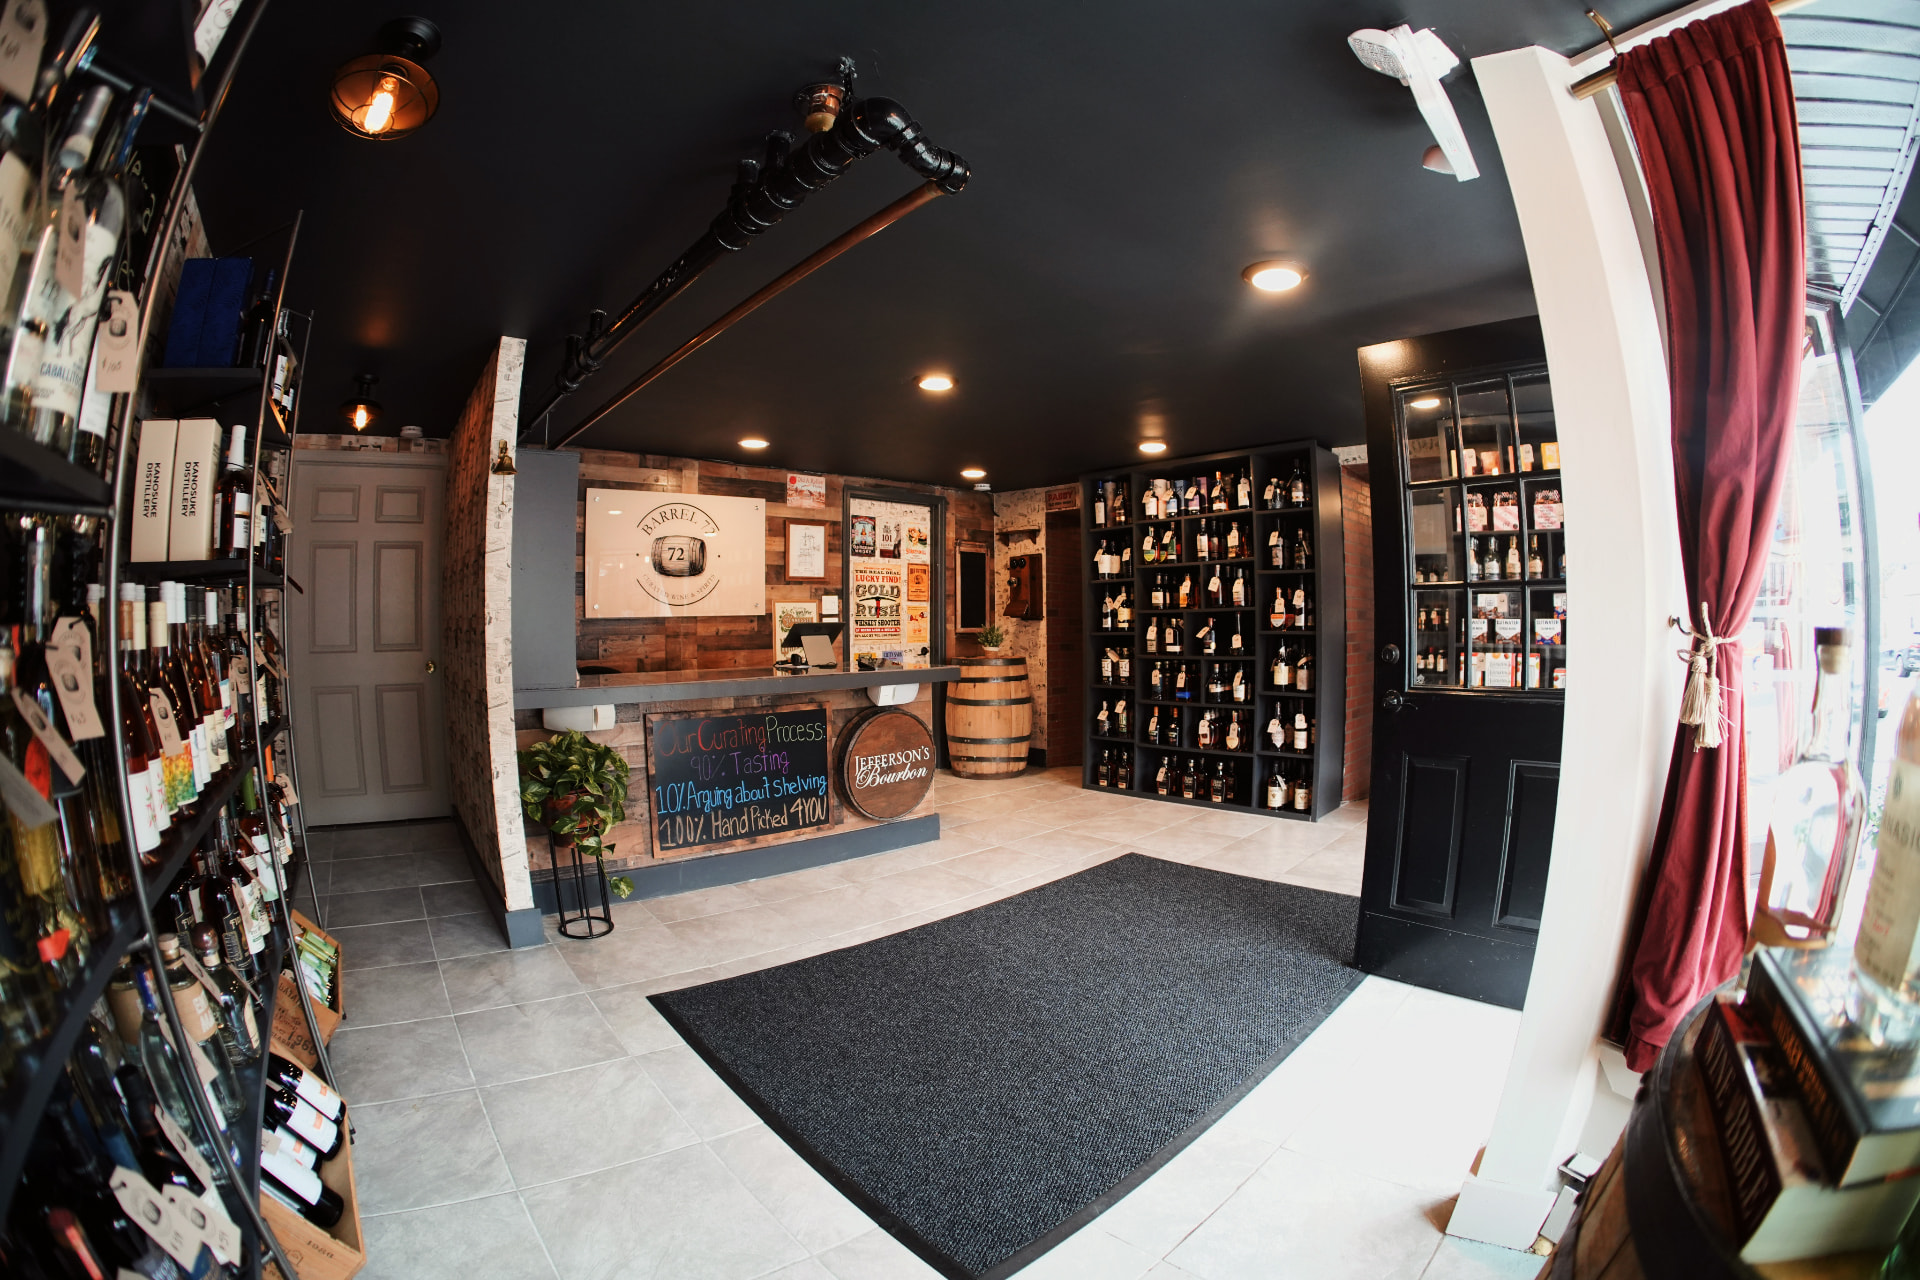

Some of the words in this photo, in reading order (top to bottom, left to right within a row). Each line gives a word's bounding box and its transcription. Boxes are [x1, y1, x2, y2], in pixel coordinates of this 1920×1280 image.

[143, 463, 154, 519] DISTILLERY
[150, 462, 161, 518] KANOSUKE
[181, 461, 192, 518] DISTILLERY
[188, 461, 199, 517] KANOSUKE
[641, 508, 697, 536] BARREL
[700, 519, 717, 534] 72
[882, 534, 892, 542] 101
[667, 547, 686, 561] 72
[642, 573, 671, 598] CURATD
[855, 575, 880, 583] LUCKY
[881, 576, 902, 584] FIND!
[855, 584, 901, 598] GOLD
[855, 602, 901, 617] RUSH
[658, 721, 697, 757] Our
[697, 718, 767, 753] Curating
[766, 715, 827, 744] Process:
[690, 753, 726, 782] 90%
[729, 748, 790, 775] Tasting
[855, 745, 931, 777] JEFFERSON'S
[855, 763, 929, 790] Bourbon
[735, 776, 771, 804] about
[773, 774, 828, 797] Shelving
[659, 814, 707, 848] 100%
[711, 807, 749, 840] Hand
[750, 803, 789, 831] Picked
[1704, 1020, 1737, 1107] WINE
[1725, 1093, 1771, 1220] BIBLE
